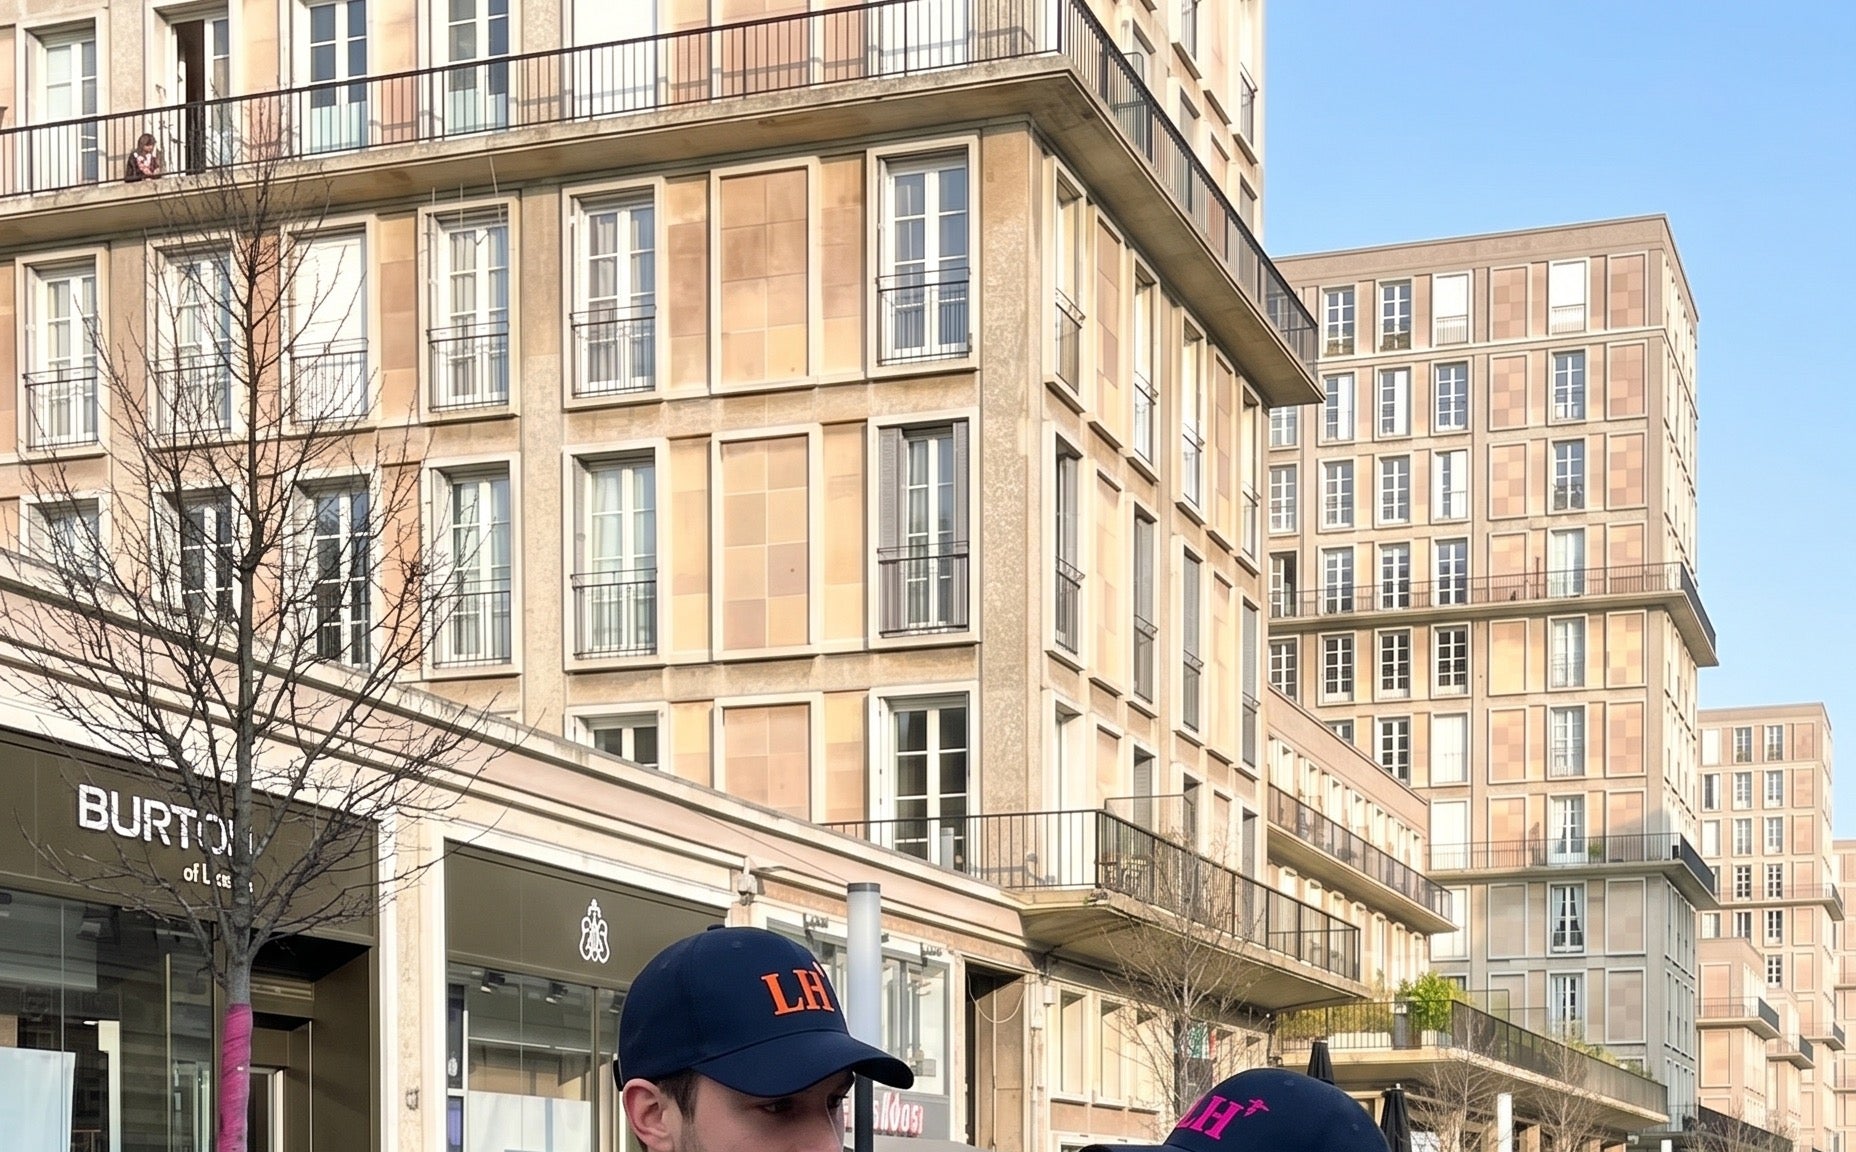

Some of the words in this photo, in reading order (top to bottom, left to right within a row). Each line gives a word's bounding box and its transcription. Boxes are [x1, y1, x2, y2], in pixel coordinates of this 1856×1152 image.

[79, 784, 253, 856] BURTO
[184, 863, 200, 882] of
[761, 969, 835, 1015] LH
